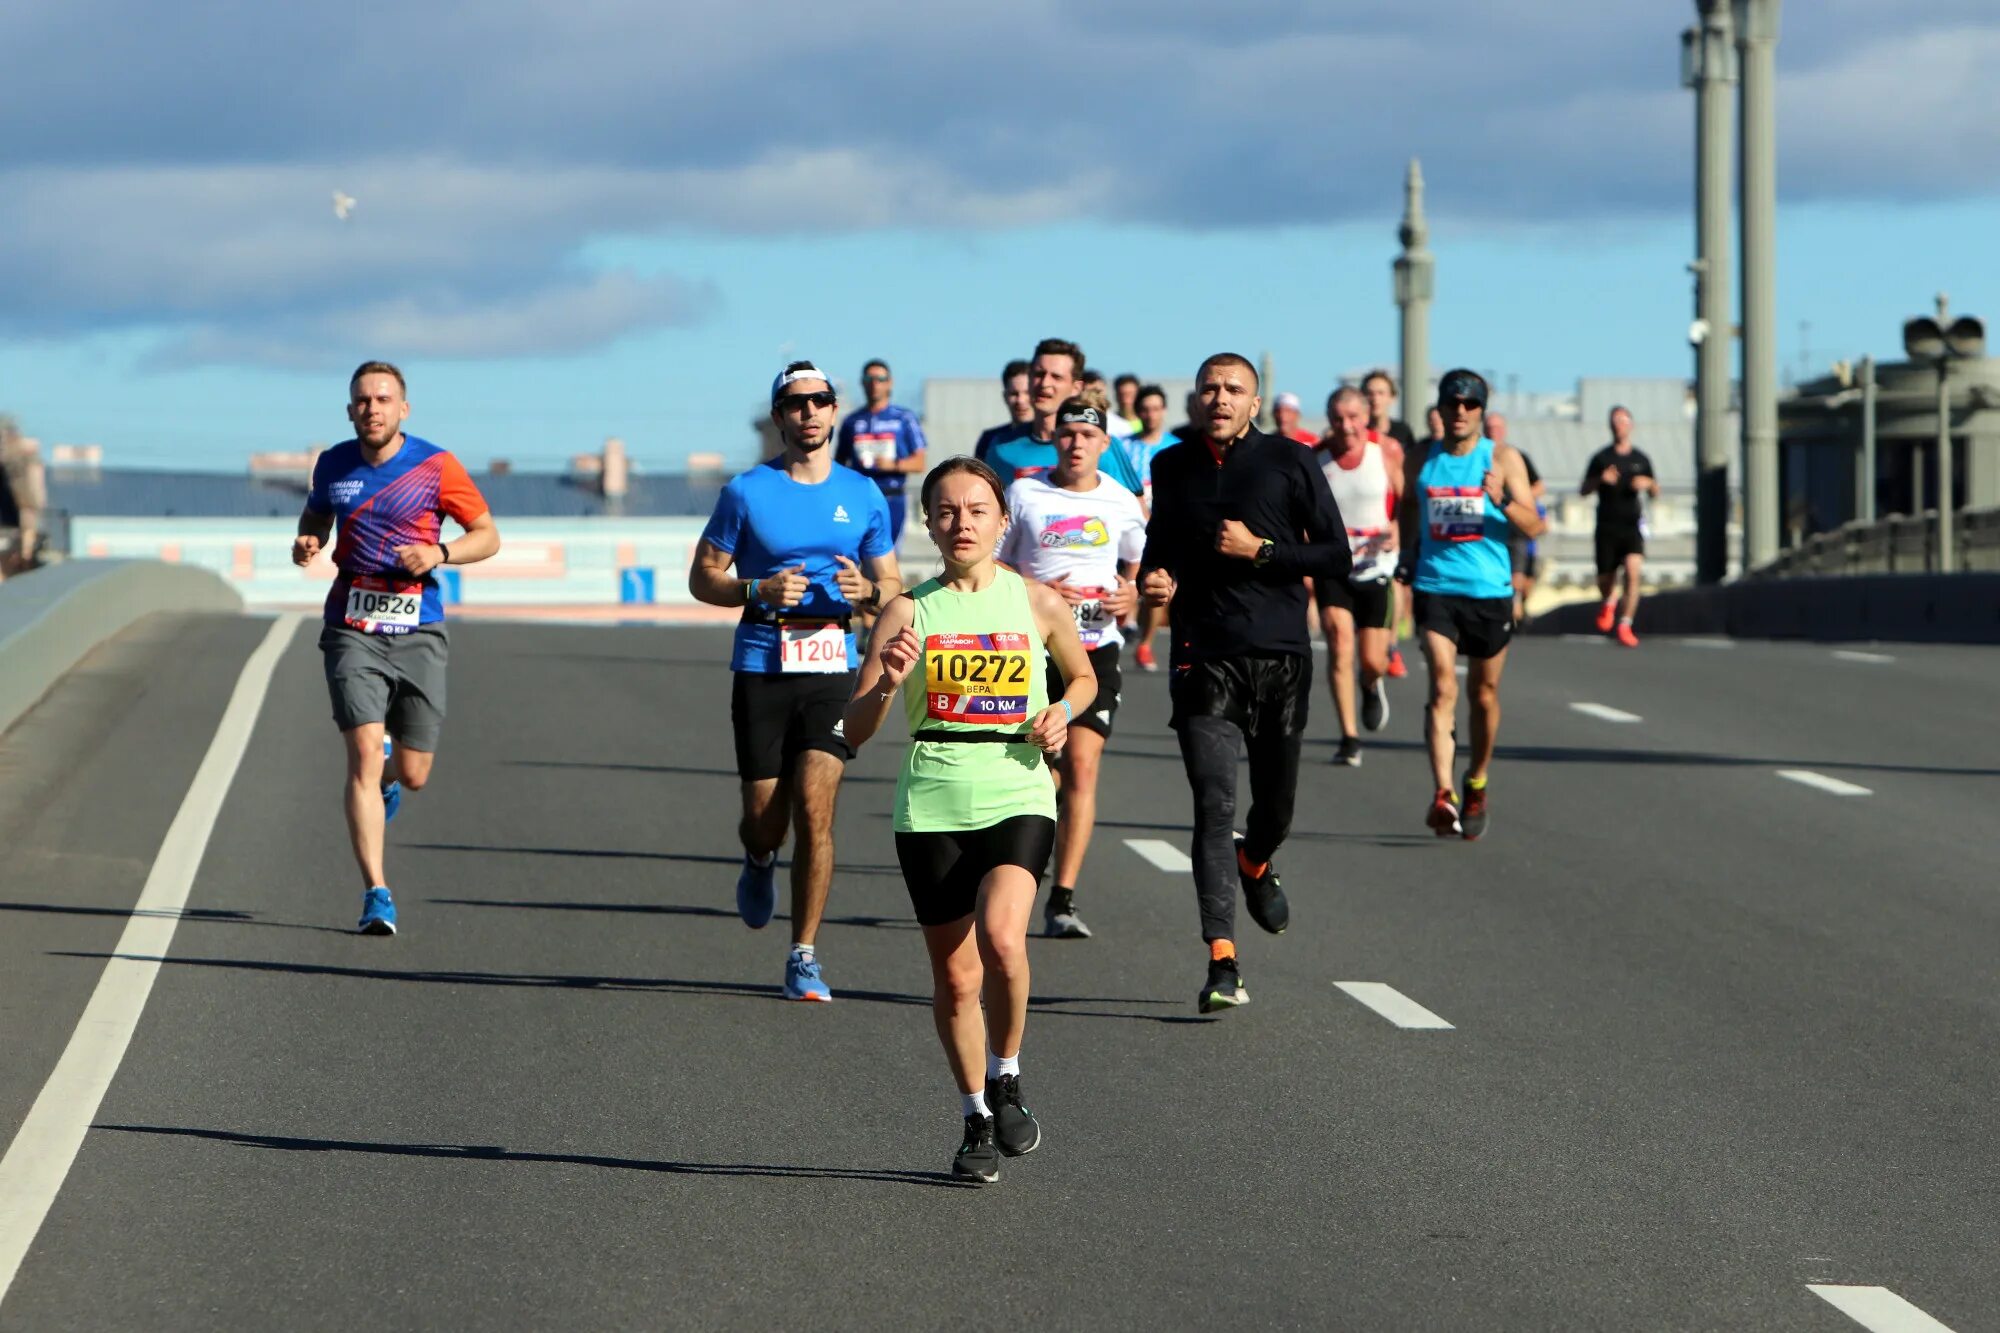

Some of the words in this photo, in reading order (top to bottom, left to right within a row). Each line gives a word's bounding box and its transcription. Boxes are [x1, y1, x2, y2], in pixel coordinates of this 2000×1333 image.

[352, 590, 416, 615] 10526
[382, 624, 393, 634] 10
[781, 639, 847, 662] 11204
[931, 653, 1027, 683] 10272
[966, 685, 992, 694] ВЕРА
[980, 700, 995, 711] 10
